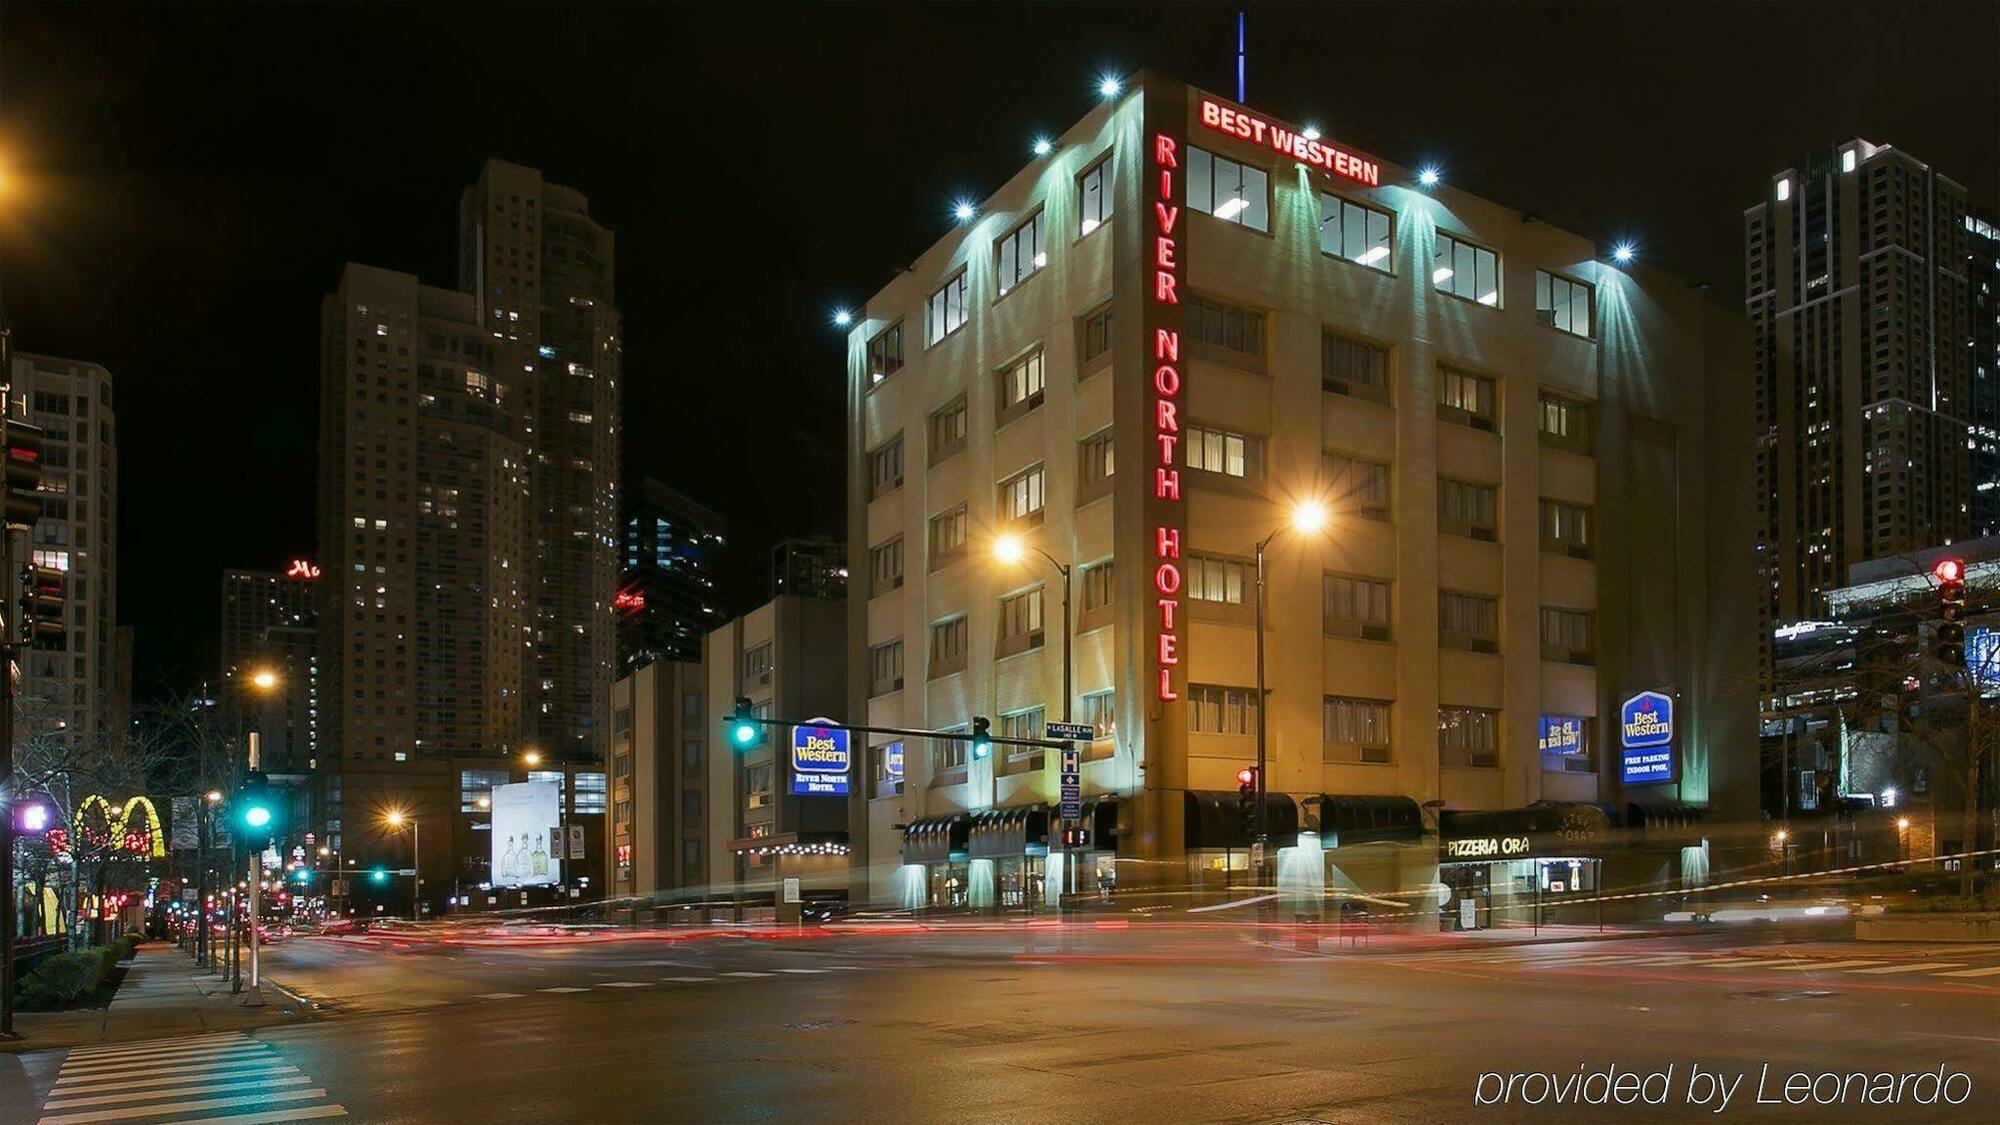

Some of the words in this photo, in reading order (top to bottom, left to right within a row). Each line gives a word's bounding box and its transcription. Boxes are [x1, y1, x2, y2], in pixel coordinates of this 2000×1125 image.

[1202, 100, 1266, 144] BEST
[1270, 125, 1378, 187] WESTERN
[1155, 133, 1179, 304] RIVER
[1155, 328, 1180, 501] NORTH
[1156, 526, 1181, 702] HOTEL
[1634, 710, 1658, 725] Best
[1625, 722, 1669, 737] Western
[806, 736, 835, 751] Best
[796, 746, 847, 763] Western
[1063, 752, 1077, 772] H
[1625, 755, 1641, 765] FREE
[1642, 753, 1669, 764] PARKING
[1627, 765, 1650, 775] INDOOR
[1651, 763, 1668, 773] POOL
[795, 773, 820, 782] RIVER
[821, 774, 847, 783] NORTH
[808, 783, 835, 792] HOTEL
[1448, 838, 1498, 856] PIZZERIA
[1502, 836, 1530, 854] ORA
